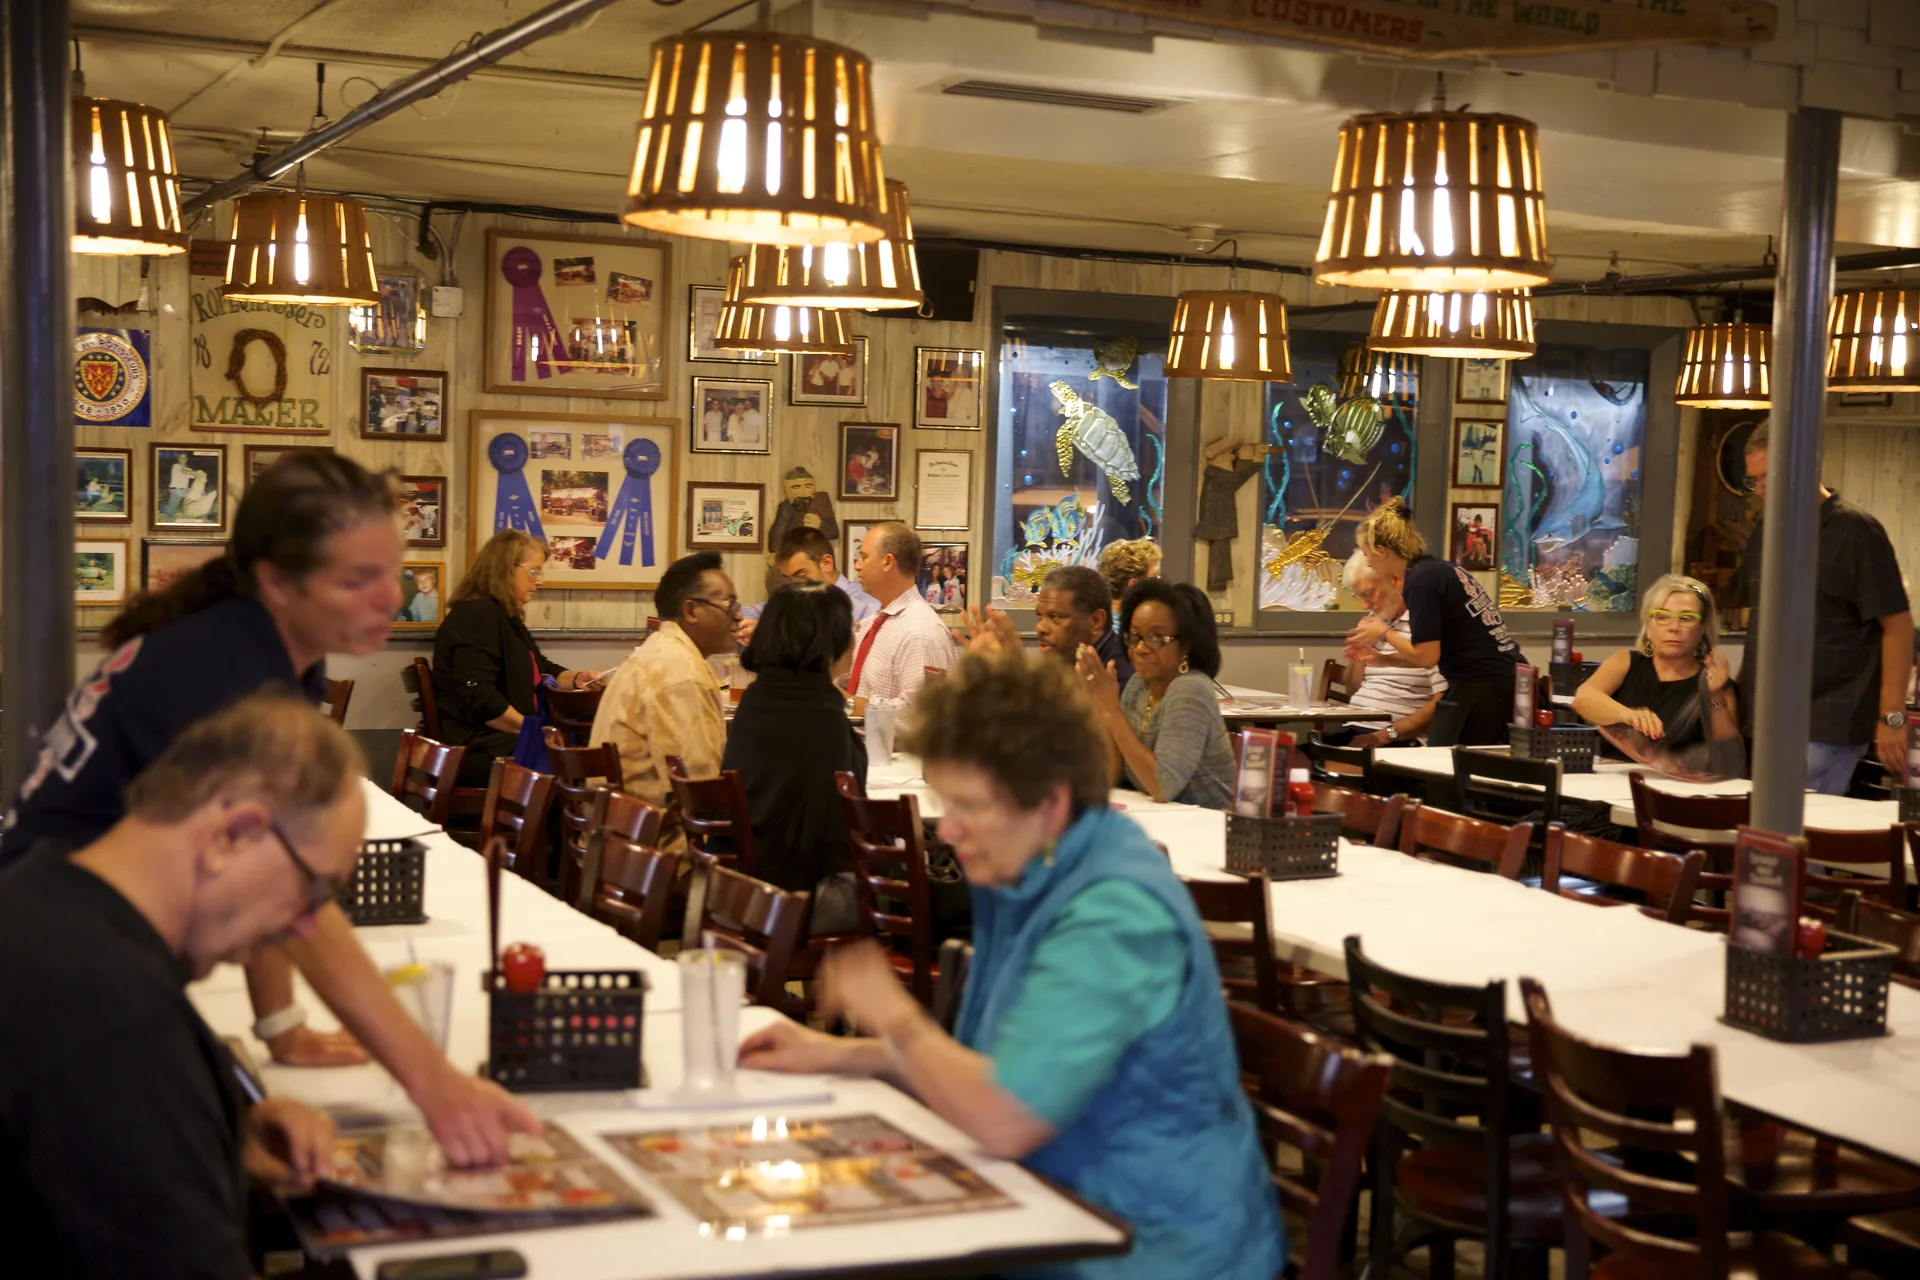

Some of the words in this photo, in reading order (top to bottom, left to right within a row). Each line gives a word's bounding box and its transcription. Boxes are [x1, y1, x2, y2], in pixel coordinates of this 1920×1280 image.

[1250, 0, 1425, 42] CUSTOMERS
[1512, 0, 1601, 35] WORLD
[193, 333, 212, 369] 18
[194, 395, 324, 428] MAKER
